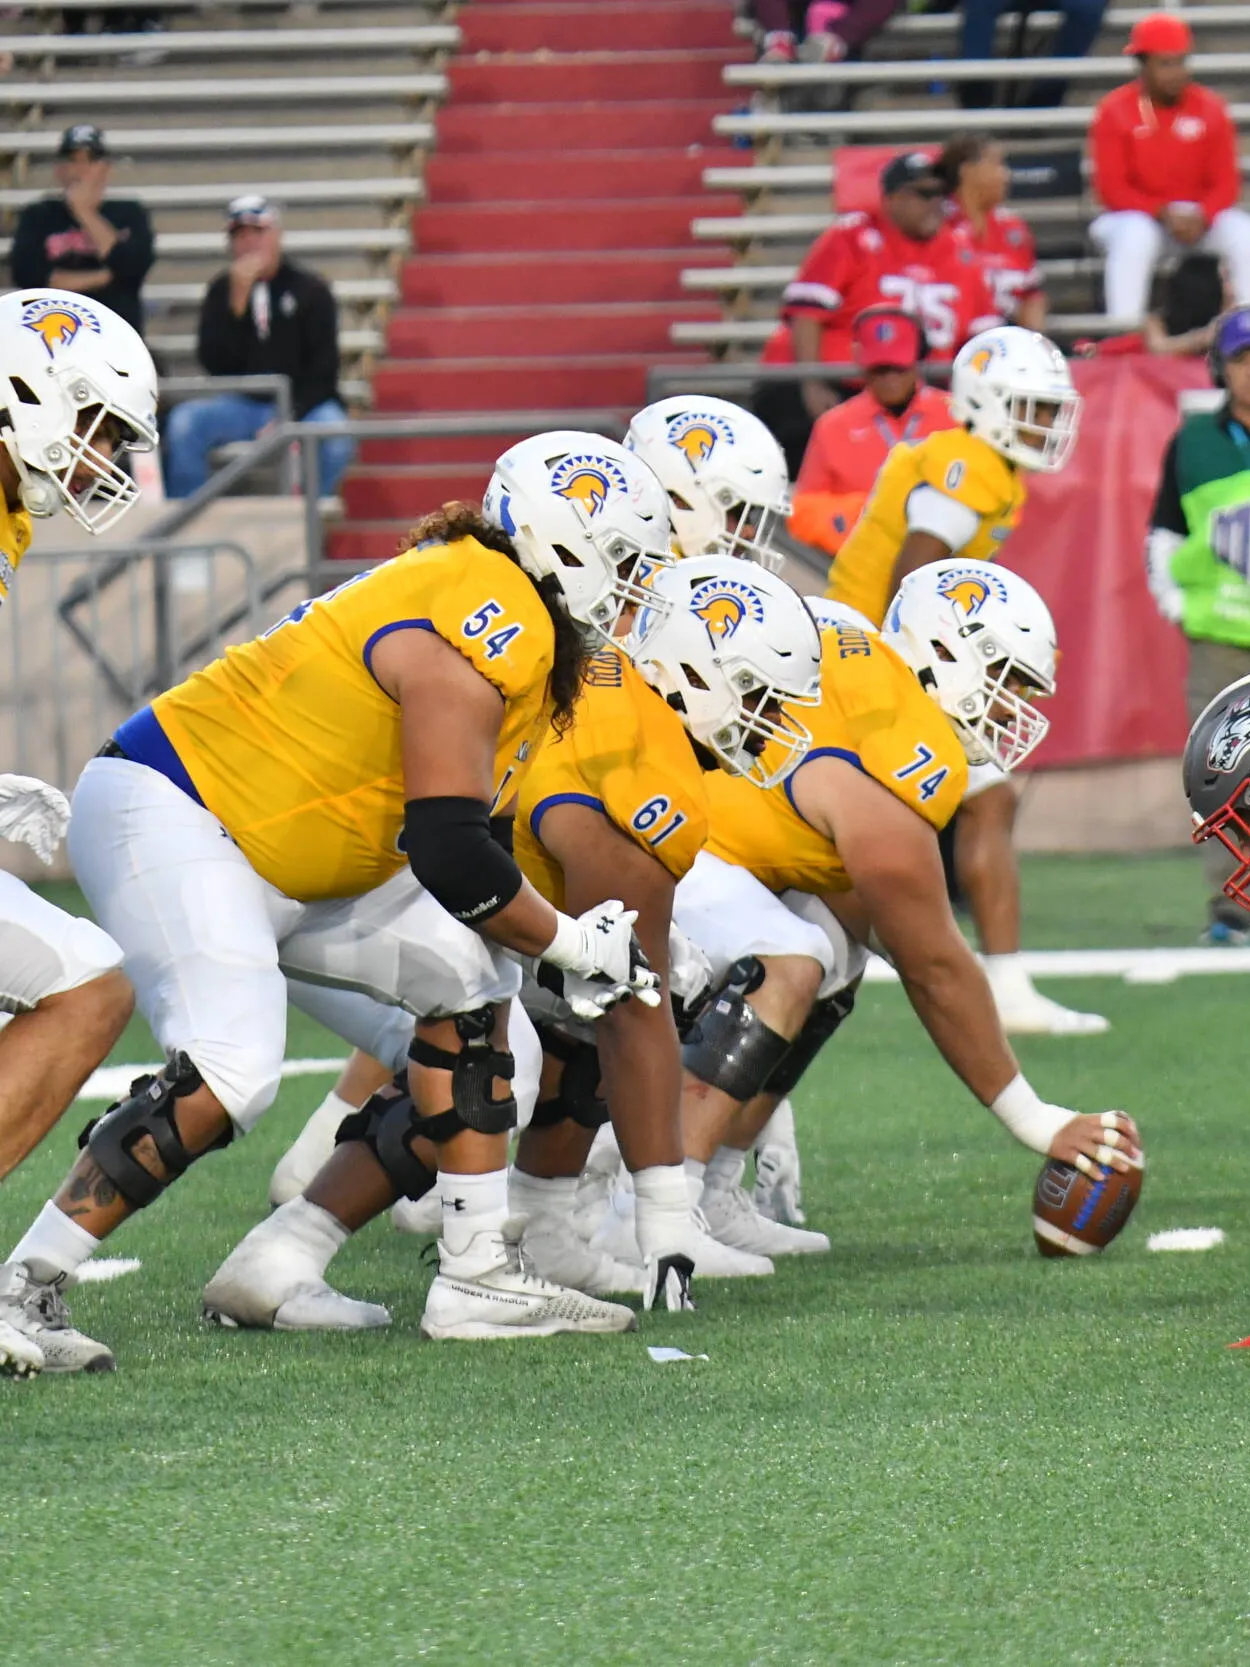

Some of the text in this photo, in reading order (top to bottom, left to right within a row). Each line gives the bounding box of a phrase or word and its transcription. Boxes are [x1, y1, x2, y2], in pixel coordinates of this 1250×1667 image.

[463, 598, 525, 661] 54
[591, 650, 622, 688] YOU
[893, 740, 951, 805] 74
[632, 794, 690, 847] 61
[451, 1284, 529, 1307] UNDER ARMOUR
